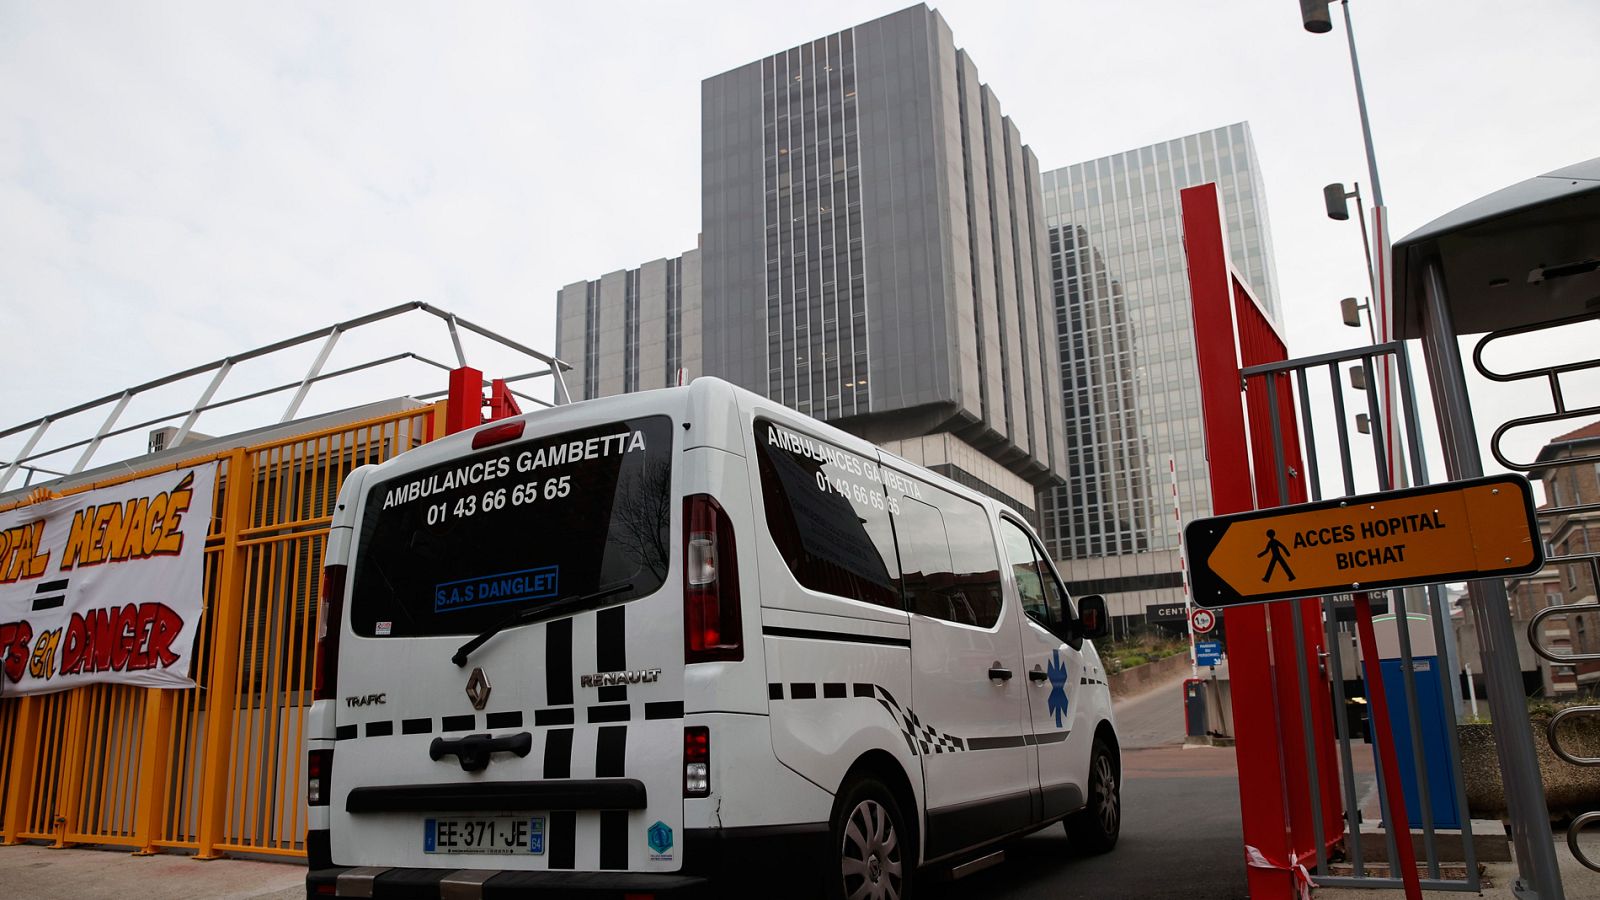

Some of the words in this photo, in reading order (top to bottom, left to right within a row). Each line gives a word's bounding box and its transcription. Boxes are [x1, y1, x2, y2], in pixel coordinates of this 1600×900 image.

[383, 455, 510, 510] AMBULANCES
[516, 430, 646, 473] GAMBETTA
[768, 426, 862, 476] AMBULANCES
[863, 462, 922, 499] GAMBETTA
[427, 502, 447, 525] 01
[453, 495, 476, 518] 43
[482, 489, 506, 512] 66
[511, 481, 537, 506] 65
[543, 475, 571, 501] 65
[815, 471, 833, 494] 01
[835, 478, 851, 499] 43
[853, 485, 868, 505] 66
[869, 490, 884, 511] 65
[60, 470, 194, 572] MENACÉ
[1293, 524, 1355, 549] ACCES
[1361, 512, 1446, 540] HOPITAL
[1336, 544, 1405, 570] BICHAT
[436, 587, 474, 606] S.A.S
[478, 572, 556, 599] DANGLET
[1158, 607, 1197, 616] CENT
[29, 627, 63, 680] en
[59, 602, 184, 676] DANGER
[580, 668, 661, 688] RENAULT
[345, 693, 387, 708] TRAFIC
[531, 837, 541, 849] 64
